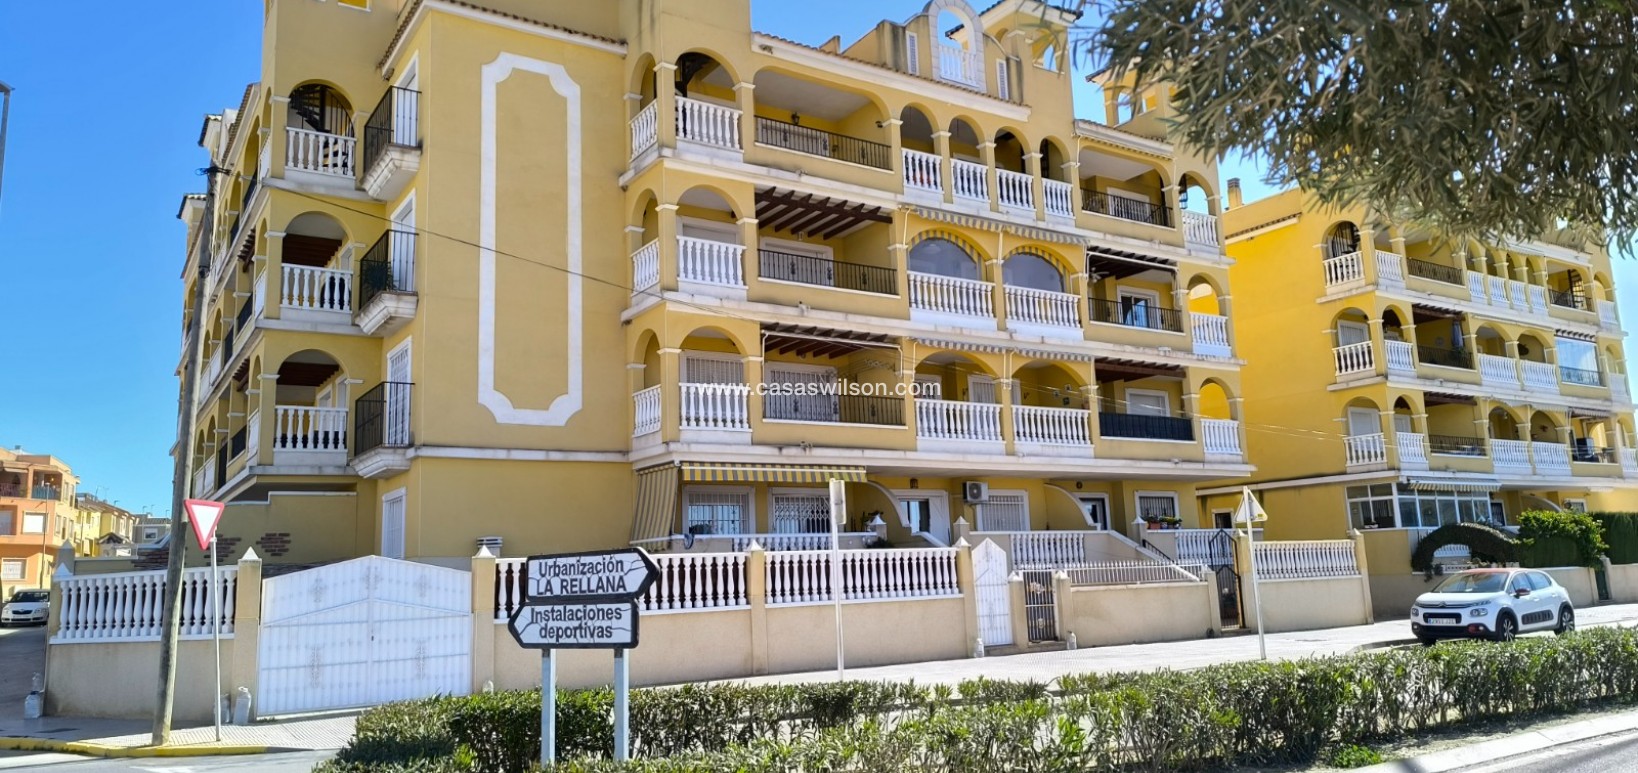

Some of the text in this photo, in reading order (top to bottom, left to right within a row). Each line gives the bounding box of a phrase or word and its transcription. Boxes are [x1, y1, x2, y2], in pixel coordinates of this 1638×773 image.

[539, 556, 624, 577] Urbanización
[536, 576, 627, 595] LA RELLANA
[530, 604, 622, 623] Instalaciones
[540, 622, 613, 643] deportivas
